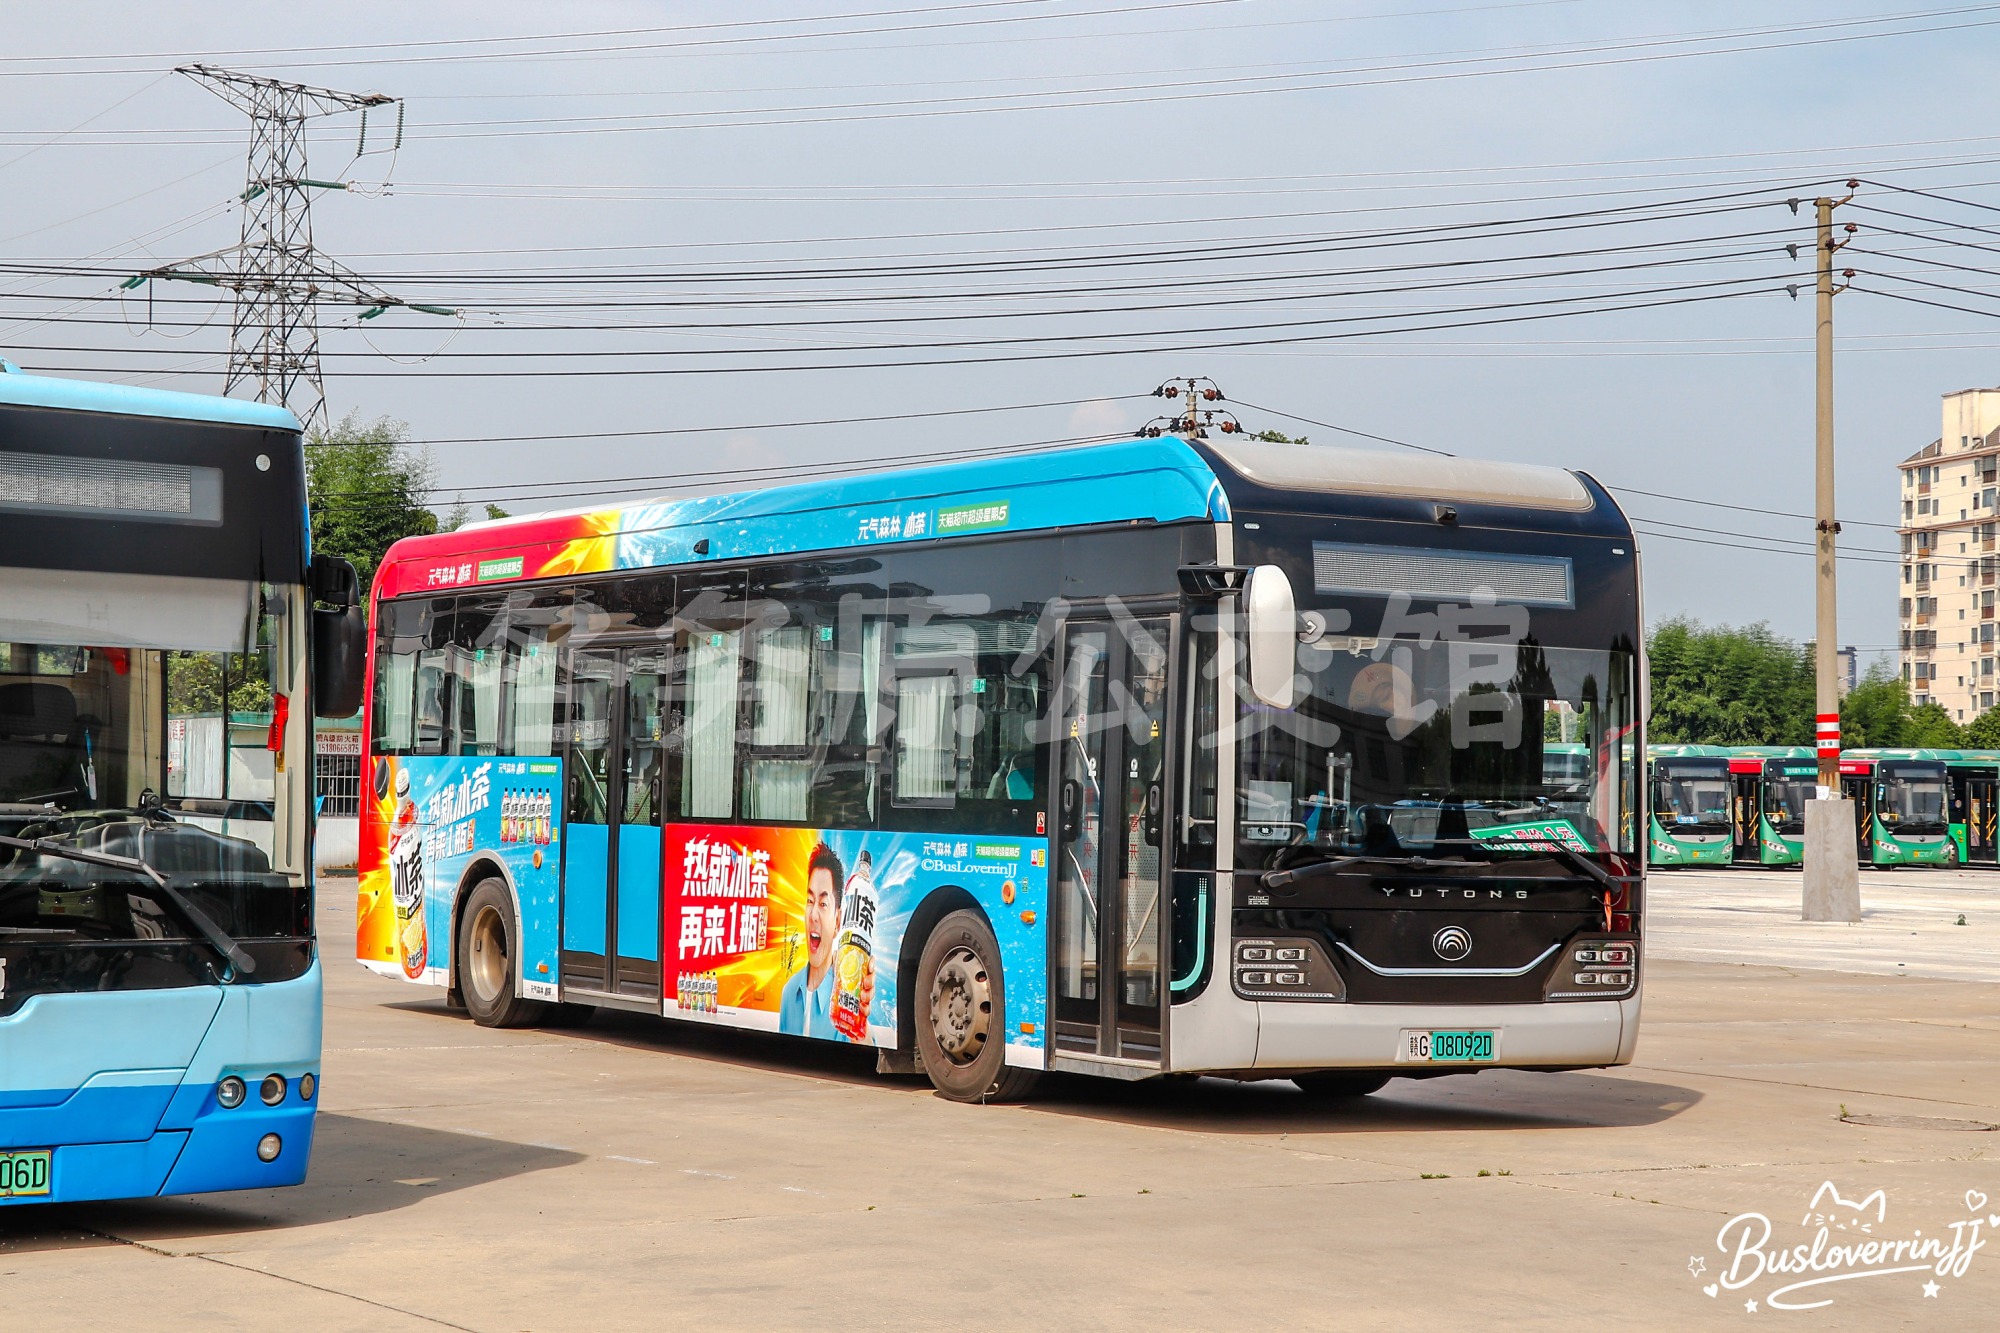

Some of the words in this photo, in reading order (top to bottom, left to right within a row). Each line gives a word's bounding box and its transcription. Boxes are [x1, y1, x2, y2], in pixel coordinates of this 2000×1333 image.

[858, 514, 901, 540] 元气森林
[938, 505, 1008, 529] 天猫超市超级星期5
[428, 566, 456, 586] 元气森林
[923, 842, 951, 856] 元气森林
[681, 834, 770, 898] 热就冰茶
[1382, 887, 1528, 899] YUTONG
[679, 901, 759, 960] 再来1瓶
